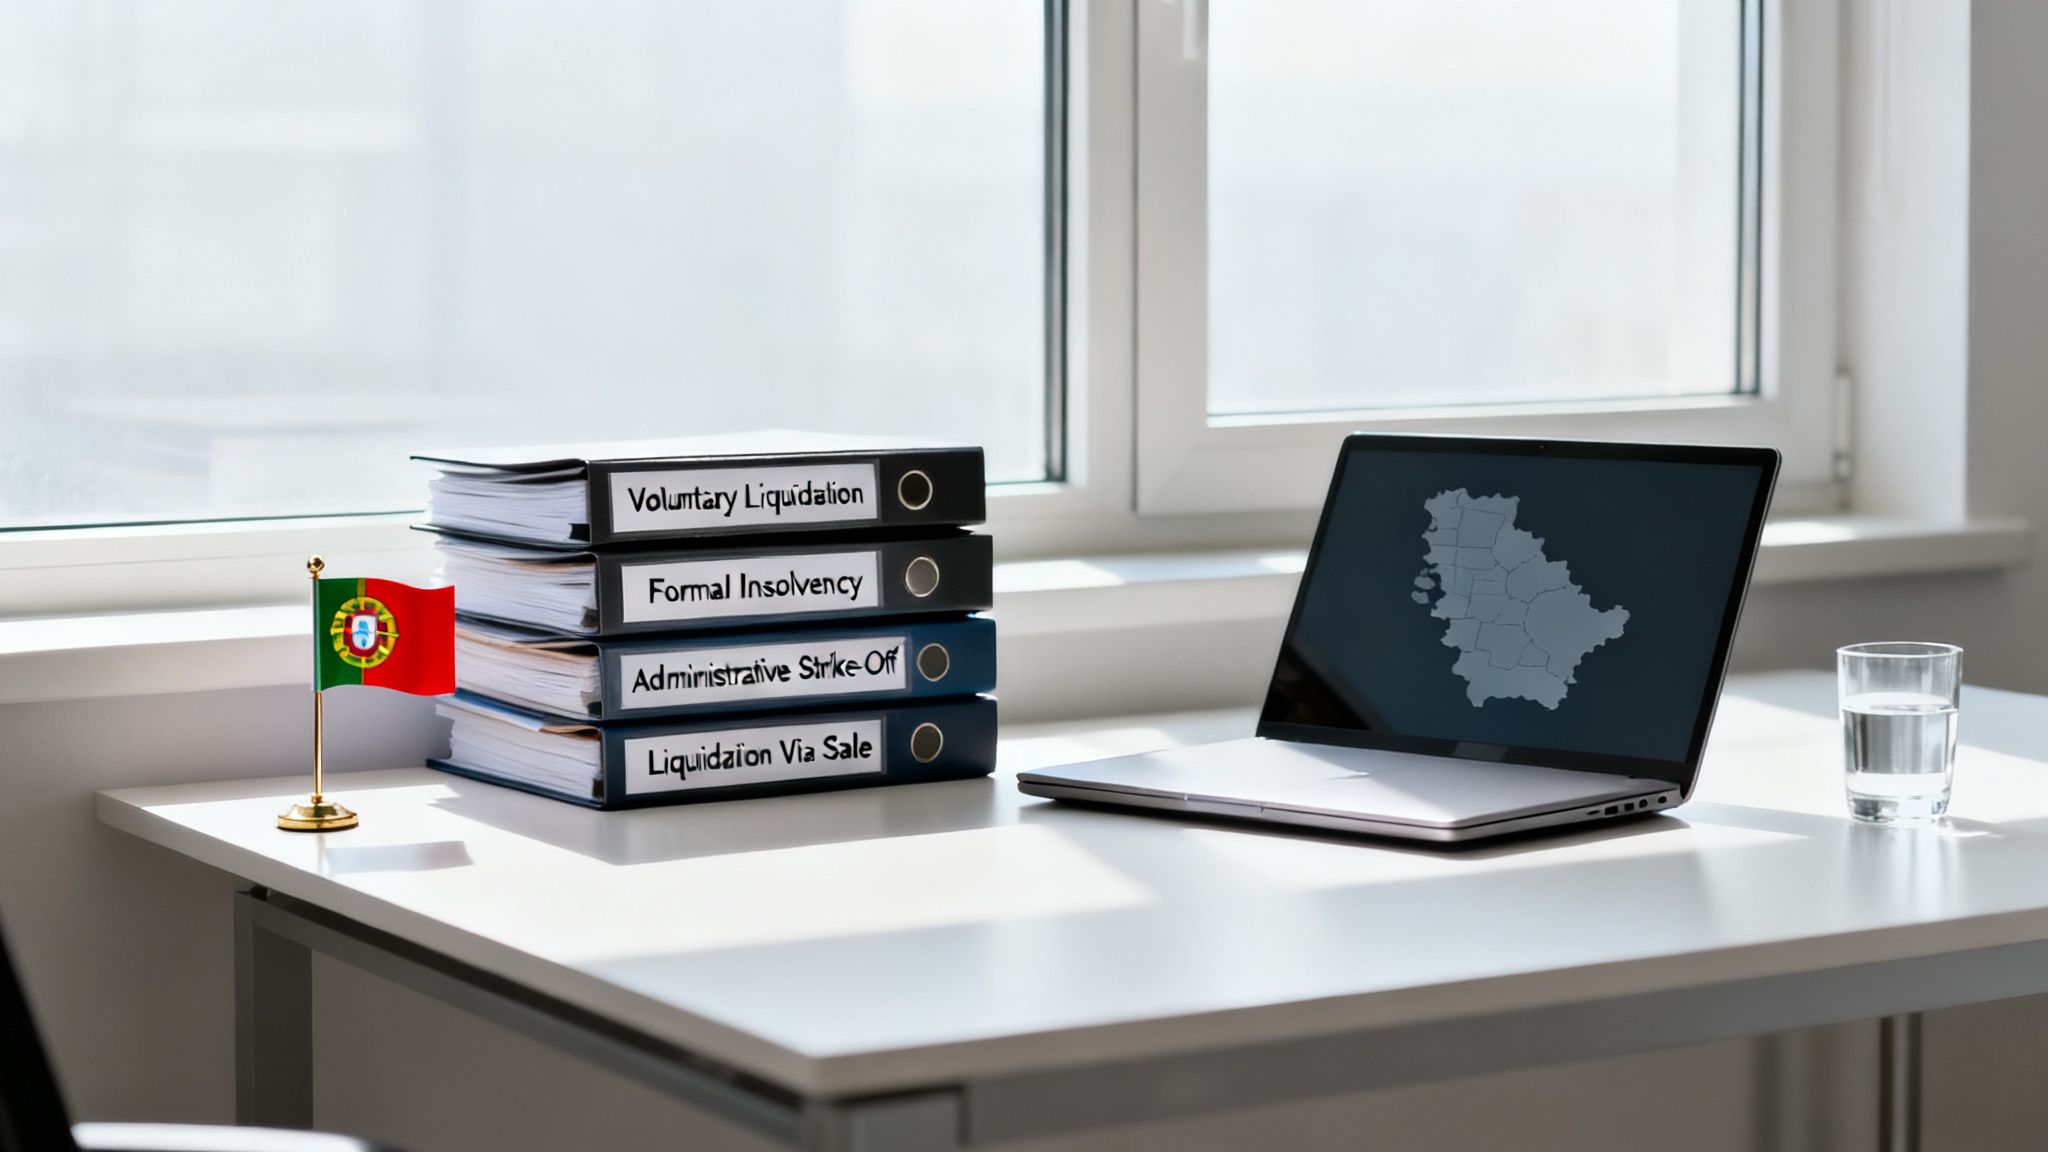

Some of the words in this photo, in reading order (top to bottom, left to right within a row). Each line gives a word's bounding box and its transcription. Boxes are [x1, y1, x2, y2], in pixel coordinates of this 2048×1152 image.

[627, 486, 738, 517] Voluntary
[745, 480, 864, 516] Liquidation
[649, 574, 730, 604] Formal
[740, 571, 863, 601] Insolvency
[632, 658, 792, 694] Administrative
[779, 738, 815, 765] Via
[823, 732, 873, 761] Sale
